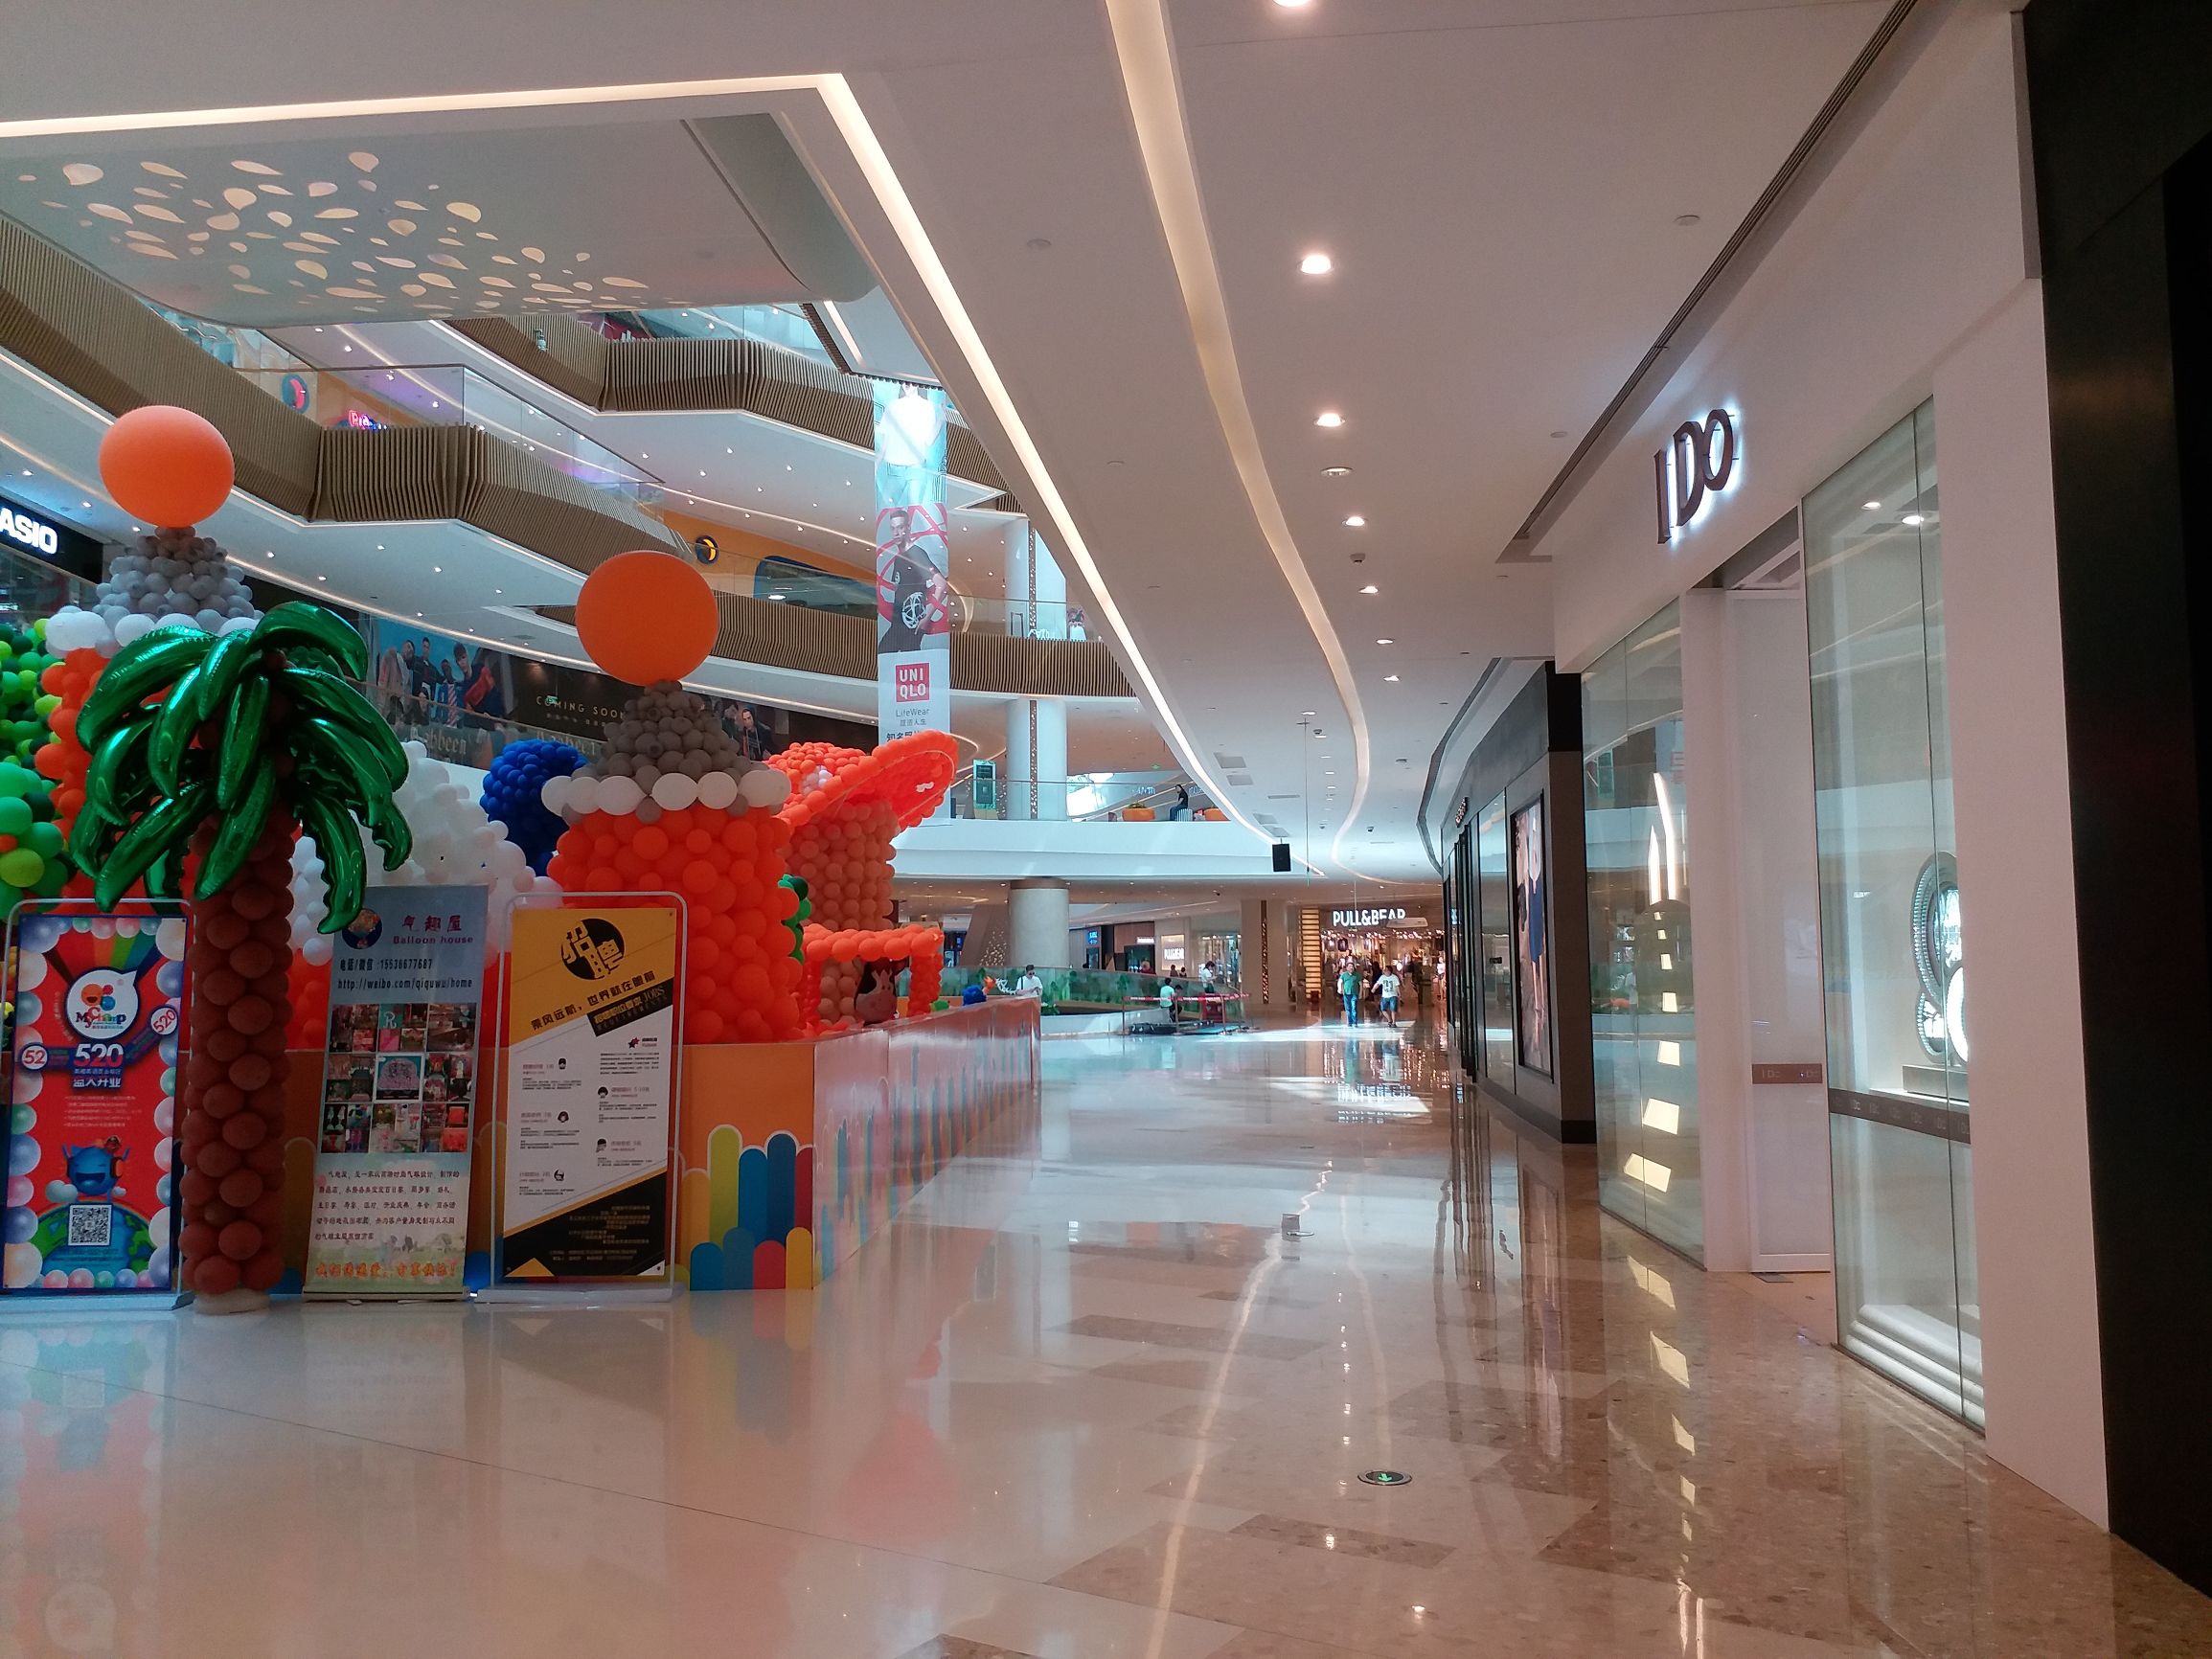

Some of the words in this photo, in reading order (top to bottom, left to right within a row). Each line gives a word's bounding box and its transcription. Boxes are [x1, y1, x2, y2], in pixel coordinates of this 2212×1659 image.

[1673, 408, 1735, 528] DO
[899, 668, 924, 682] UNI
[900, 683, 926, 700] QLO
[895, 708, 930, 717] LifeWear
[393, 936, 436, 944] Balloon
[440, 935, 473, 944] house
[153, 1008, 177, 1034] 520
[23, 1049, 46, 1065] 52
[74, 1043, 125, 1068] 520
